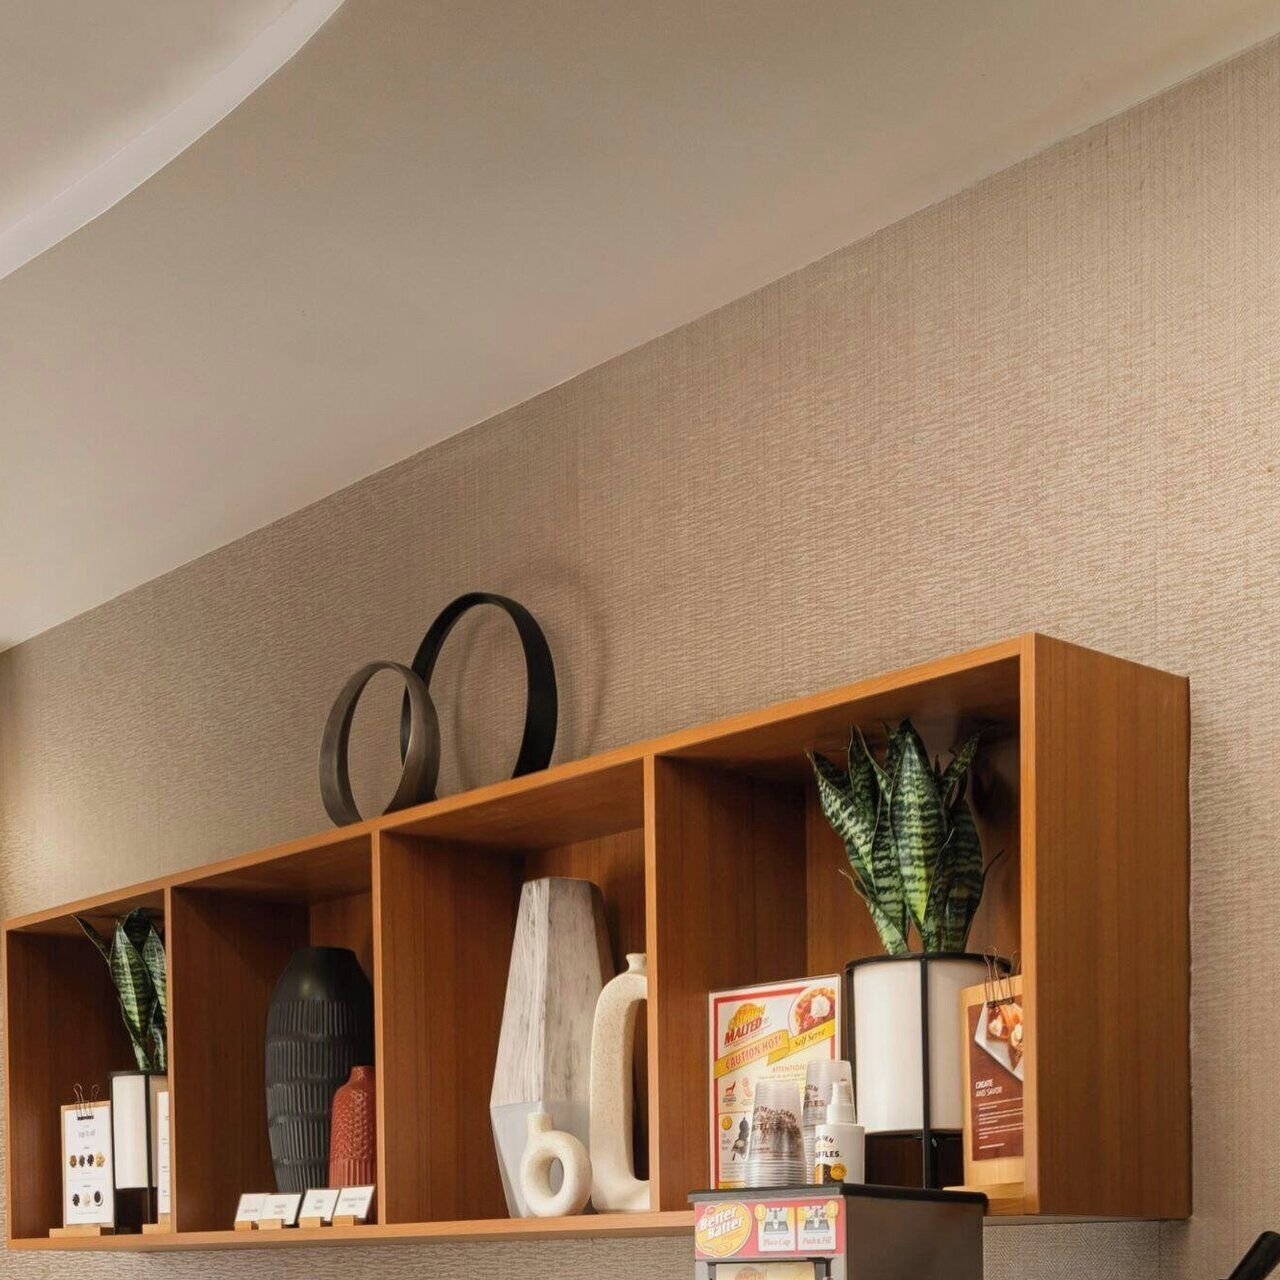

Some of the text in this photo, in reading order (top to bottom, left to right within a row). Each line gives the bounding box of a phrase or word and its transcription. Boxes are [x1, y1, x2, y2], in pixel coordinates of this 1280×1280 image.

[724, 1017, 762, 1045] MALTED
[725, 1035, 782, 1070] CAUTION HOT!
[699, 1206, 737, 1230] Better
[707, 1216, 744, 1240] Batter
